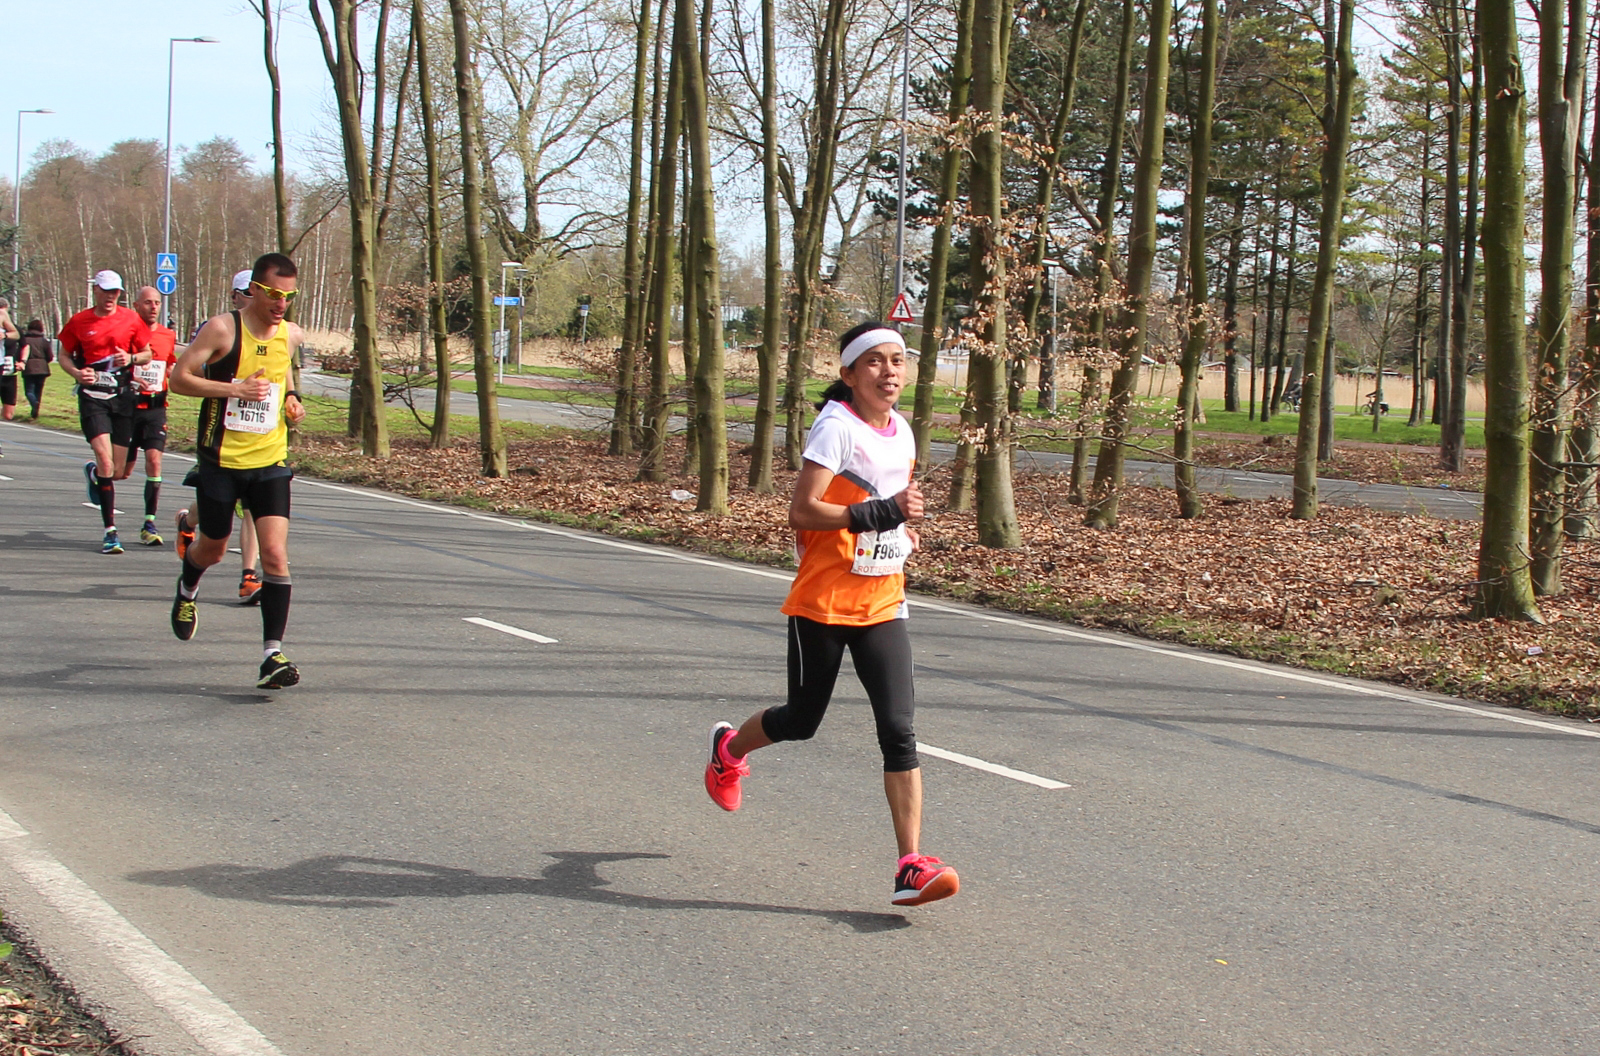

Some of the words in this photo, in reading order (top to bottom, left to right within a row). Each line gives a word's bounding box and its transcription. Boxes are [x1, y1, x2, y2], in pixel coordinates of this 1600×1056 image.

[238, 398, 271, 412] ENRIQUE
[240, 409, 266, 424] 16716
[873, 541, 905, 560] F985
